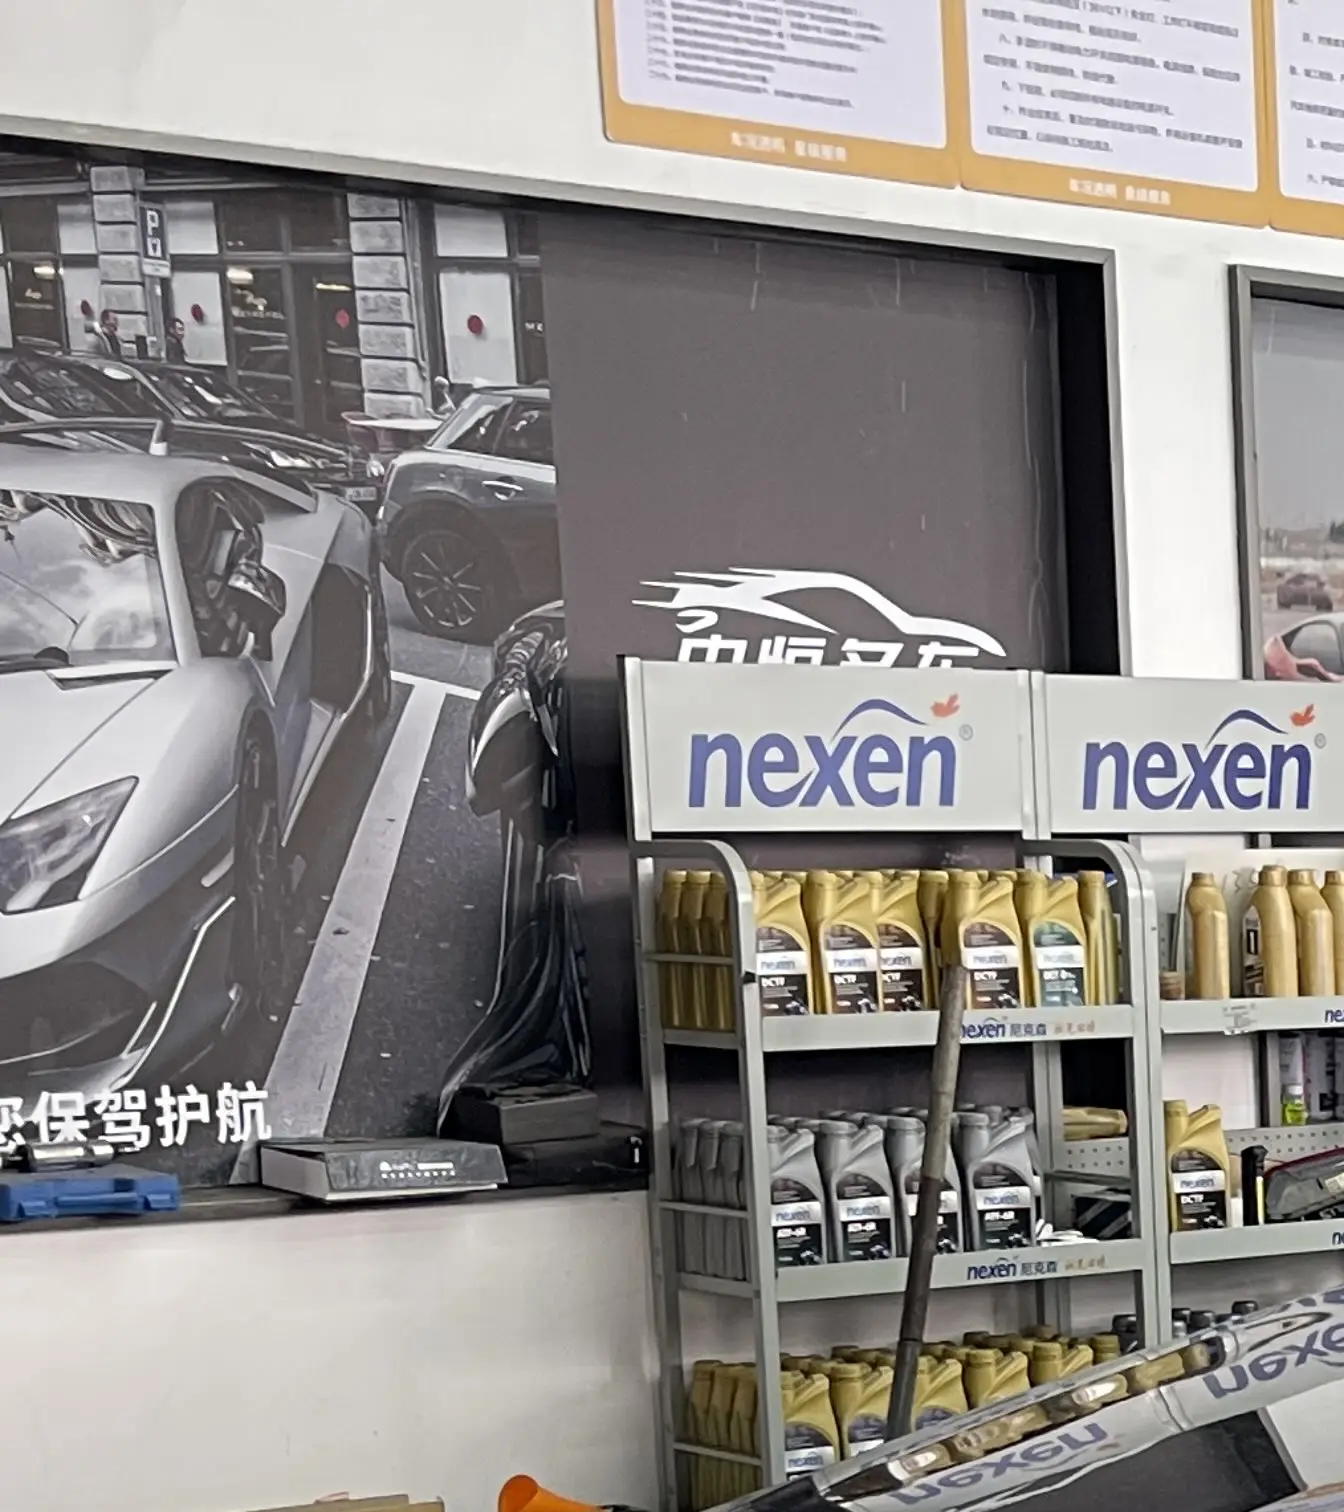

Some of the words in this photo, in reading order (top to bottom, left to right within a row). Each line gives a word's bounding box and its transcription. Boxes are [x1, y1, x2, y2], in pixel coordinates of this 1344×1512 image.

[688, 733, 957, 808] nexen
[1082, 741, 1312, 810] nexen
[967, 1262, 1017, 1281] nexen
